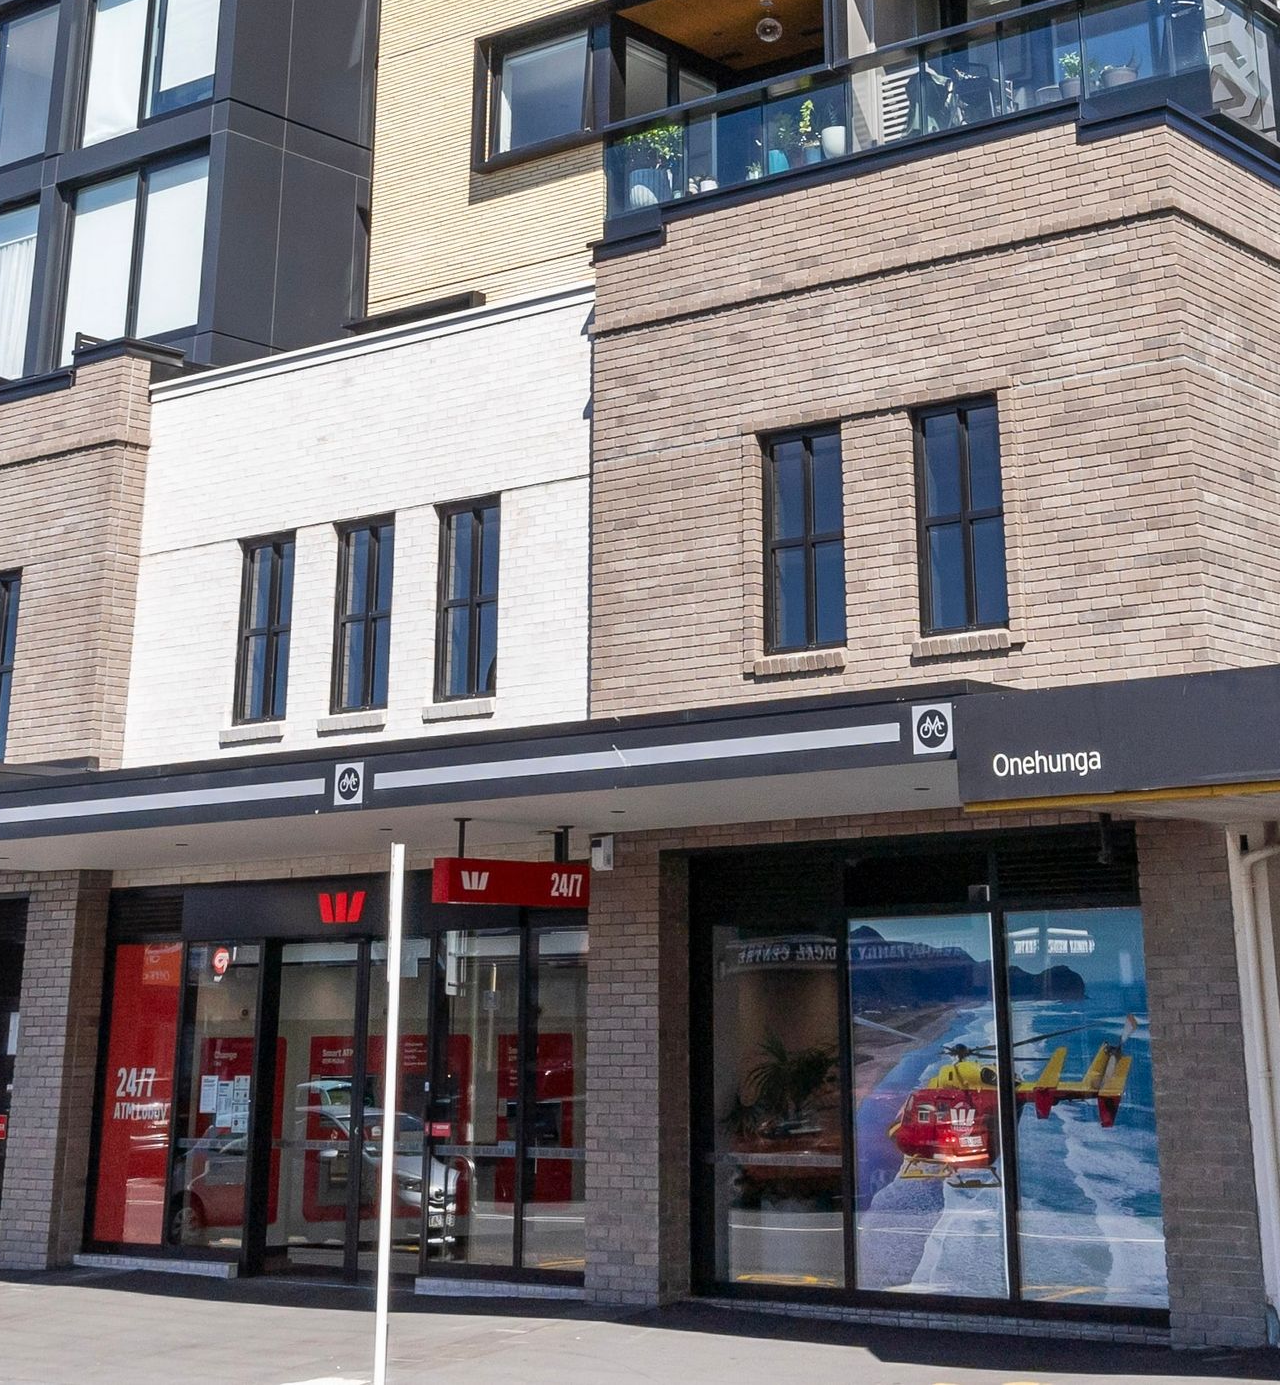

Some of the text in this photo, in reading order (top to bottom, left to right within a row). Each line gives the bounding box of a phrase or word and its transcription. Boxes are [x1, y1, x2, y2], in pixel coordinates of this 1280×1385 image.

[993, 750, 1102, 777] Onehunga
[550, 872, 583, 898] 24/7
[115, 1067, 156, 1098] 24/7
[113, 1103, 134, 1120] ATM
